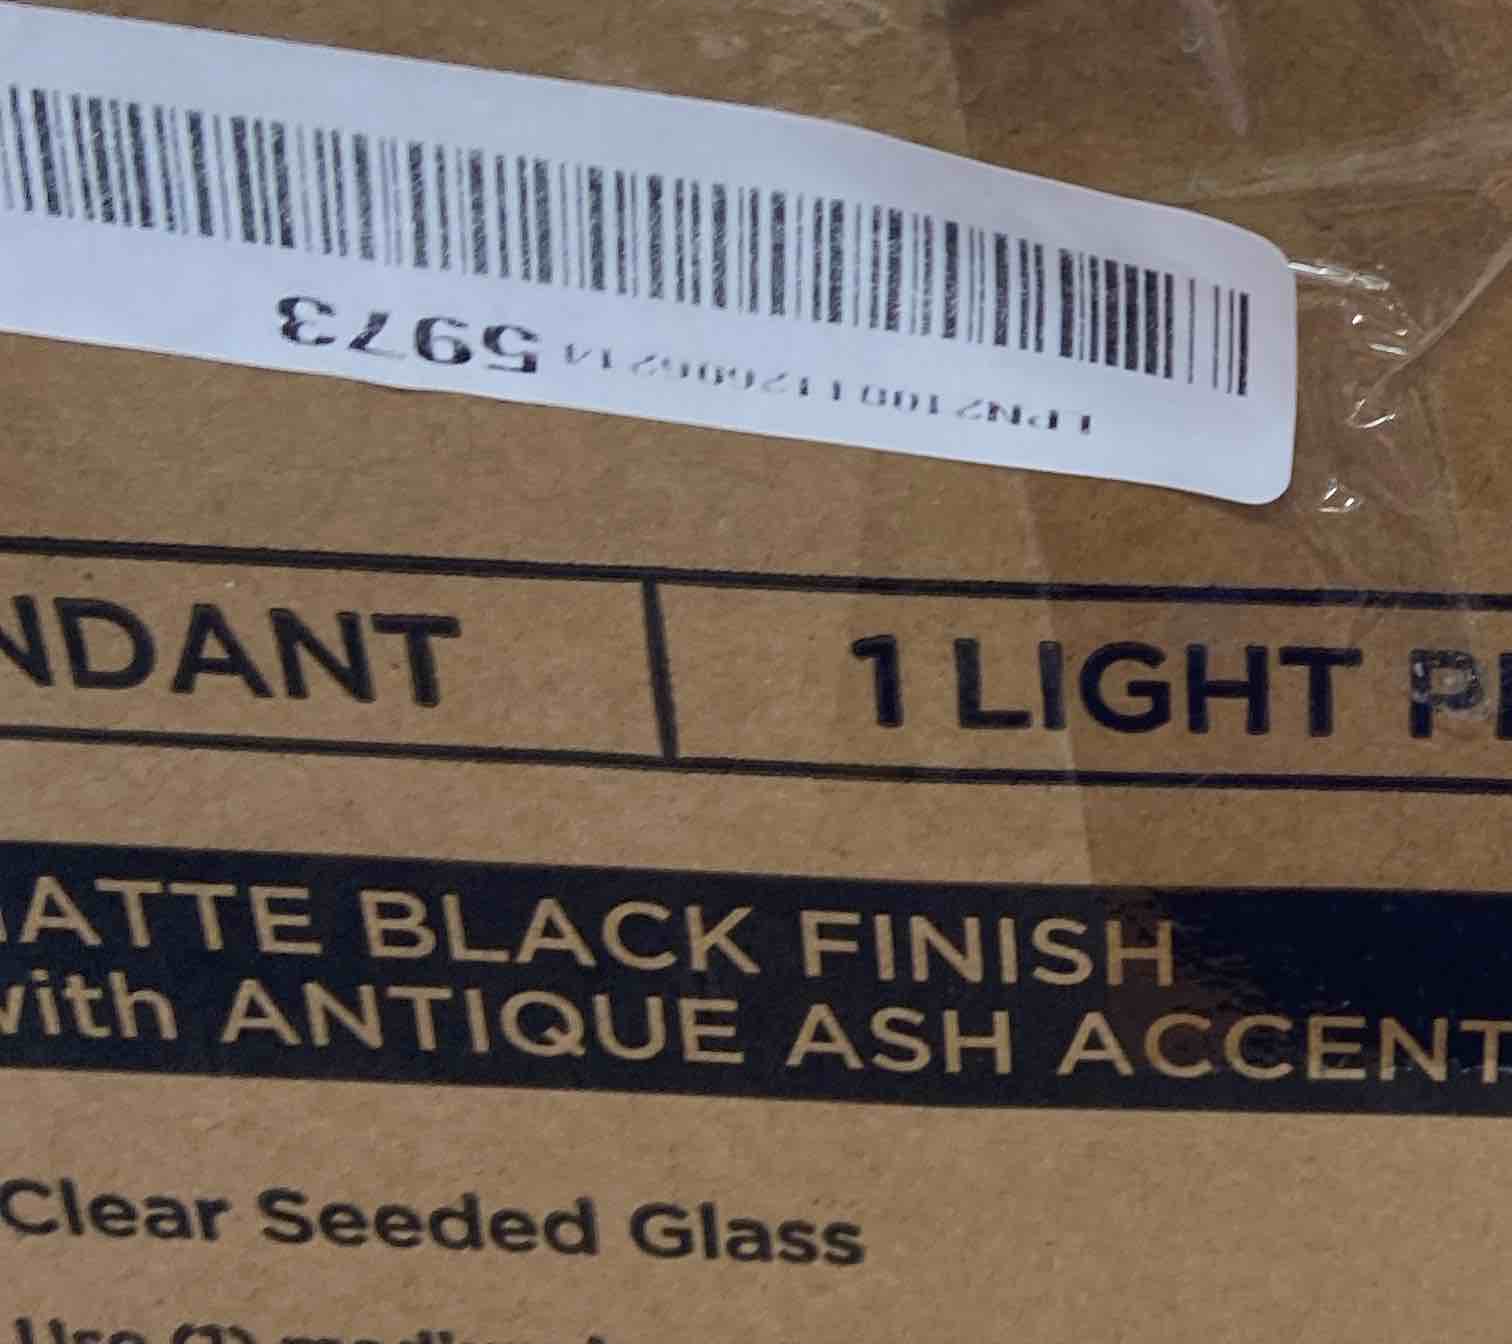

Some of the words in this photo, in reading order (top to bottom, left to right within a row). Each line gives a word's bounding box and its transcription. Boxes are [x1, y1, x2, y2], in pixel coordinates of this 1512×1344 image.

[273, 292, 541, 375] 5973
[851, 634, 908, 728] 1
[952, 635, 1363, 738] LIGHT
[0, 875, 322, 955] ATTE
[358, 887, 761, 976] BLACK
[799, 908, 1177, 989] FINISH
[219, 976, 745, 1067] ANTIQUE
[785, 1003, 1010, 1077] ASH
[0, 1178, 230, 1244] Clear
[257, 1188, 599, 1256] Seeded
[628, 1203, 866, 1267] Glass
